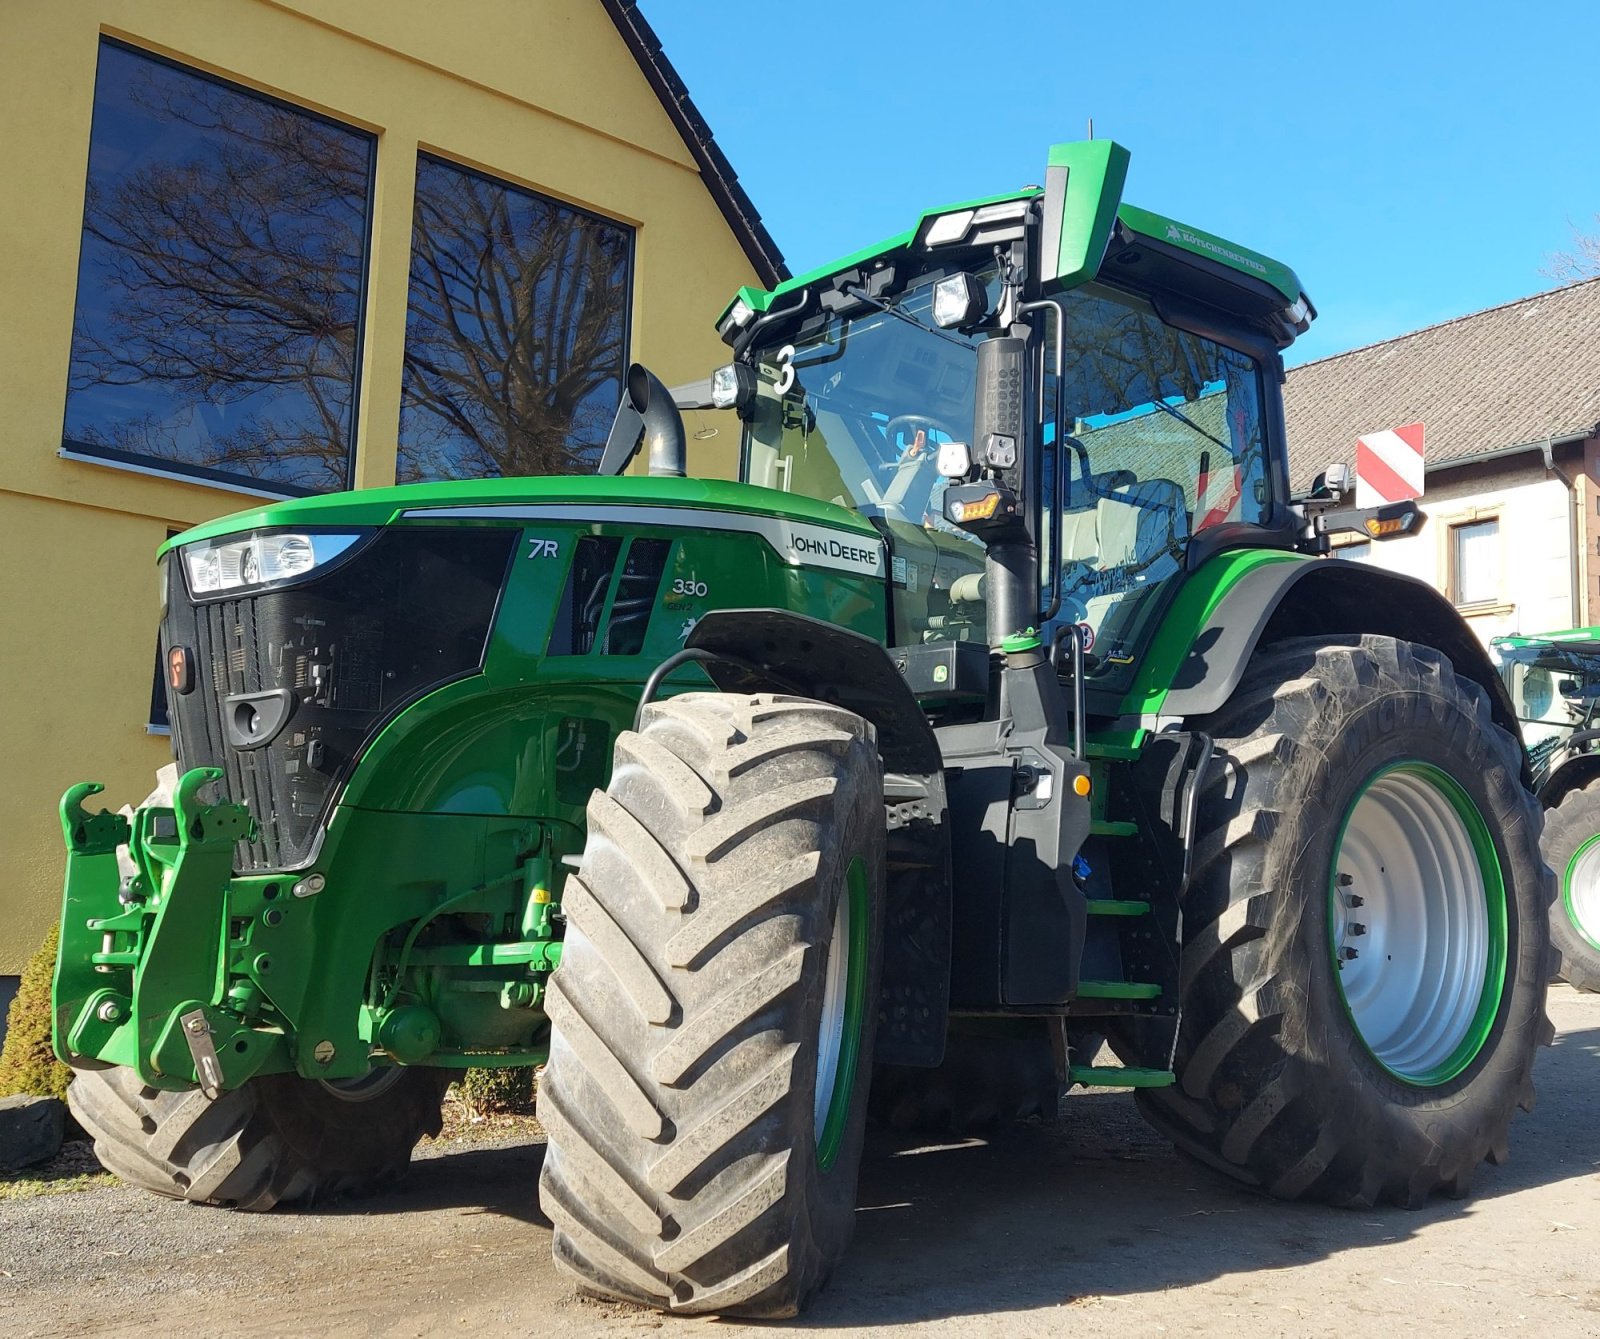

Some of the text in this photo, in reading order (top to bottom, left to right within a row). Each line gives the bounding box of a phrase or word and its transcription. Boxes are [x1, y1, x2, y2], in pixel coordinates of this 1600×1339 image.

[774, 344, 795, 395] 3
[528, 538, 558, 559] 7R
[786, 533, 877, 565] JOHN DEERE
[672, 578, 708, 597] 330
